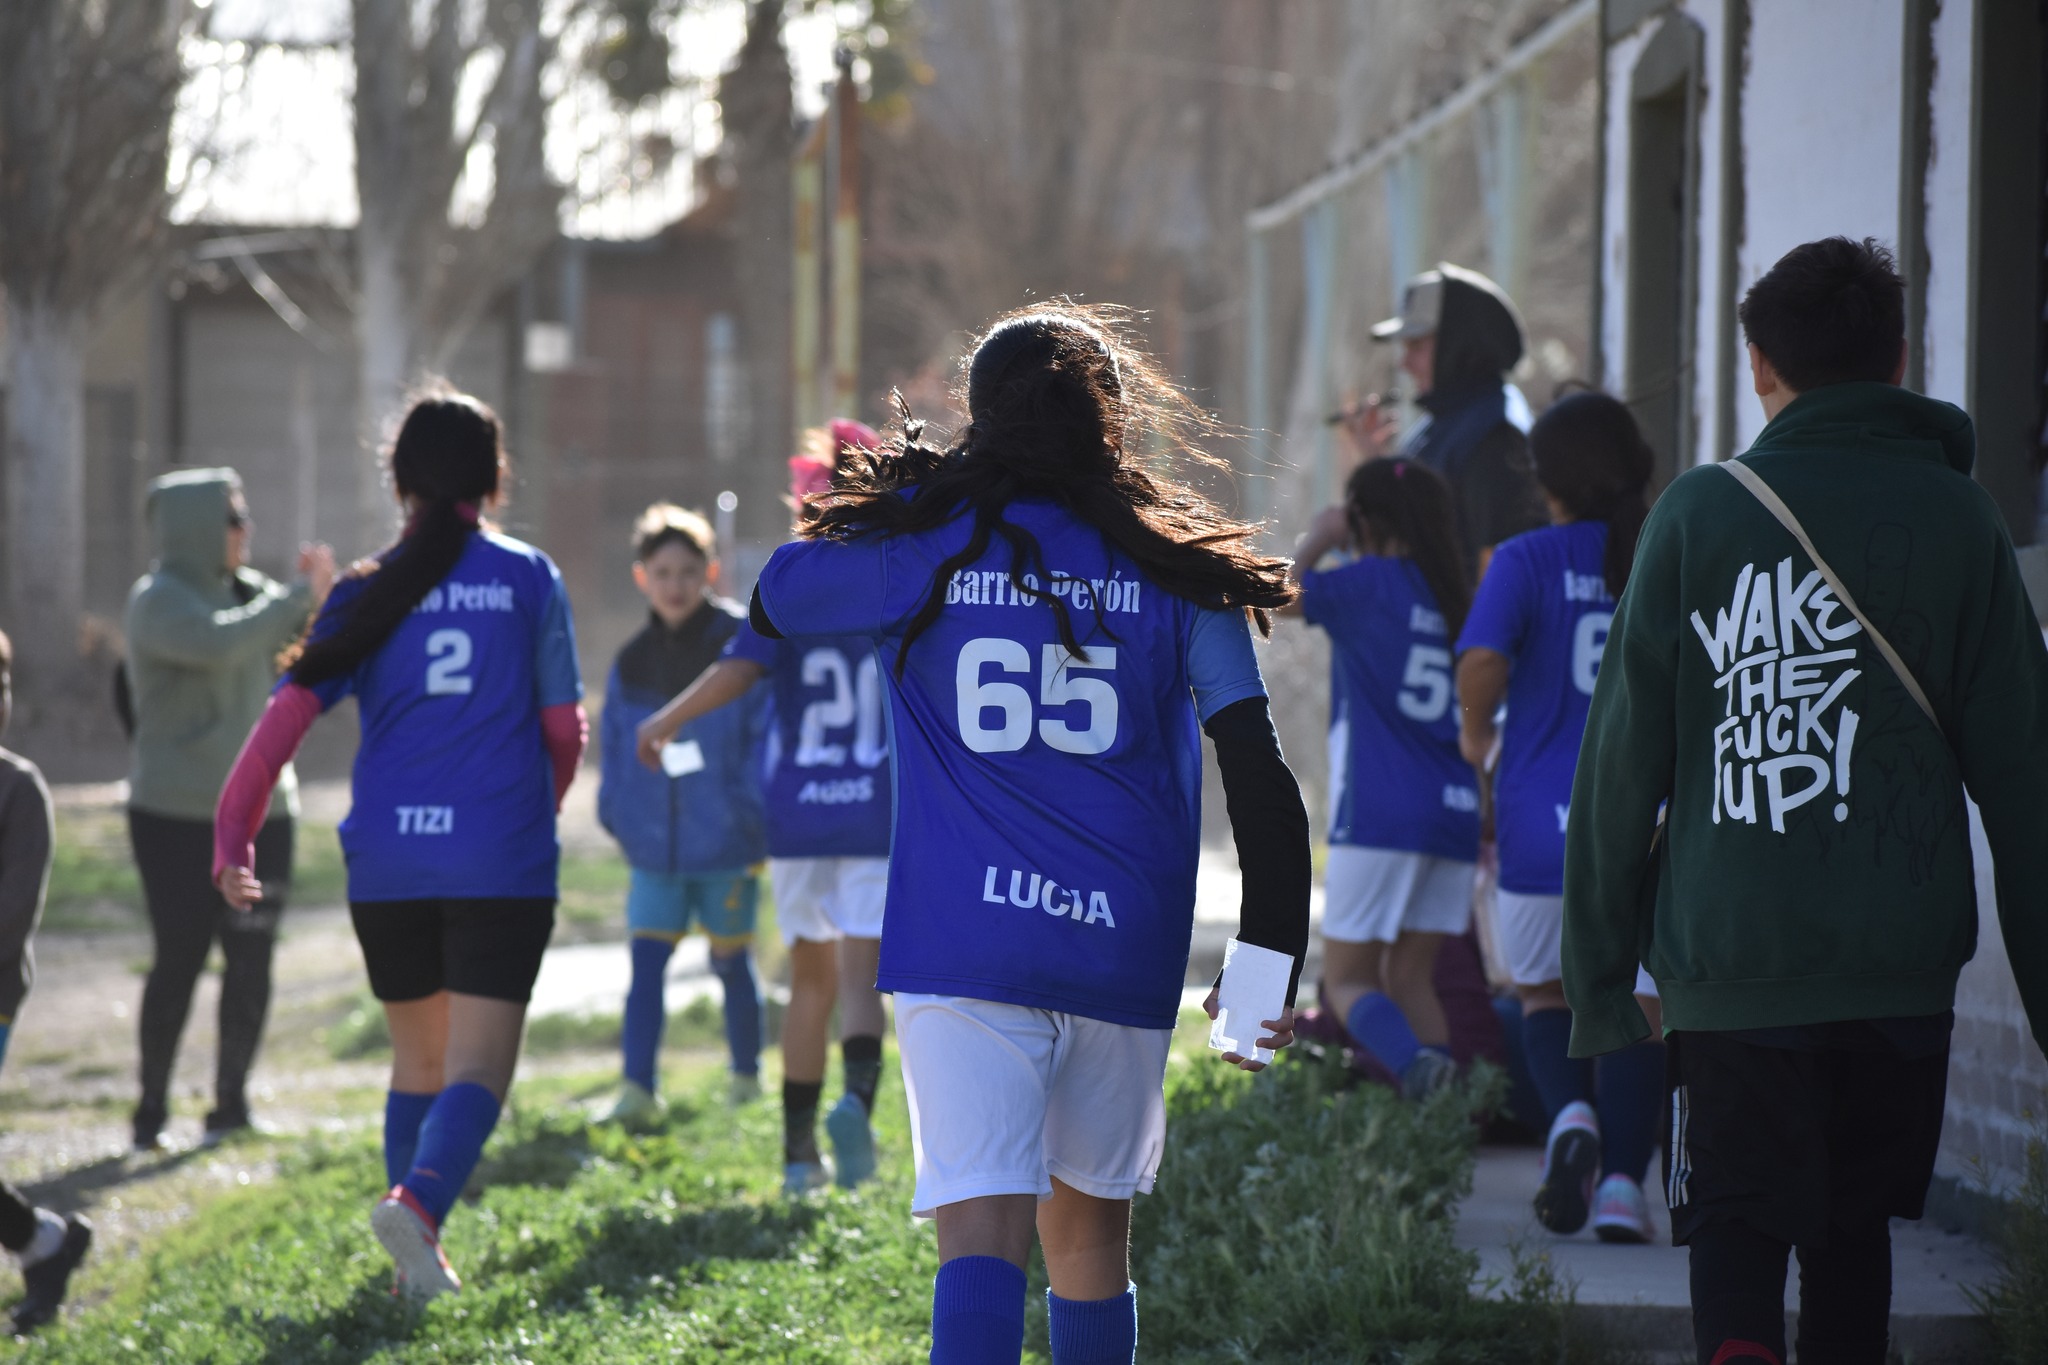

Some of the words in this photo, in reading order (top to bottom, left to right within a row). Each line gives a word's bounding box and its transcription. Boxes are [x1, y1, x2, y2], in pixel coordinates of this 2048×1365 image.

[1690, 556, 1862, 673] WAKE
[426, 628, 473, 694] 2
[1714, 649, 1857, 717] THE
[956, 637, 1119, 755] 65
[1713, 668, 1862, 824] FUCK
[395, 805, 454, 834] TIZI
[983, 865, 1116, 928] LUCIA
